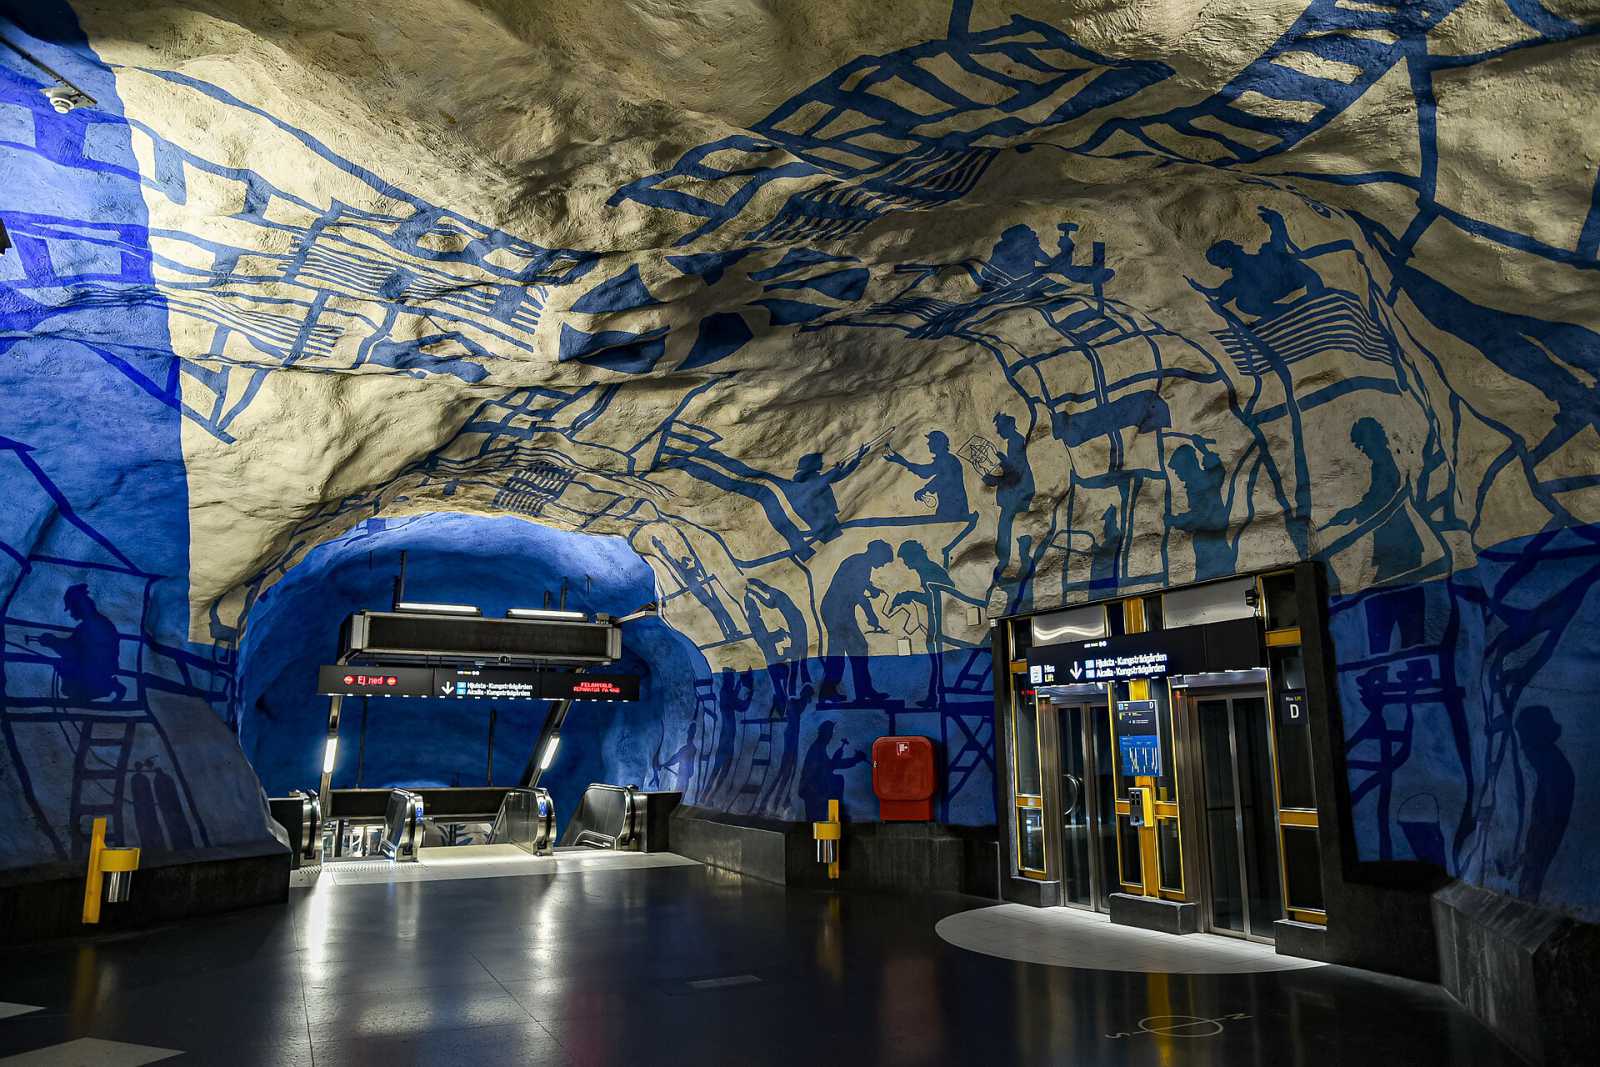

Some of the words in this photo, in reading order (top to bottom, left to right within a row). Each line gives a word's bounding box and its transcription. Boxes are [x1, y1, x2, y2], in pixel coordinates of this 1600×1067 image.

[1095, 658, 1115, 668] Hjulsta
[357, 675, 366, 686] Ej
[368, 676, 383, 685] ned
[1289, 703, 1300, 719] D
